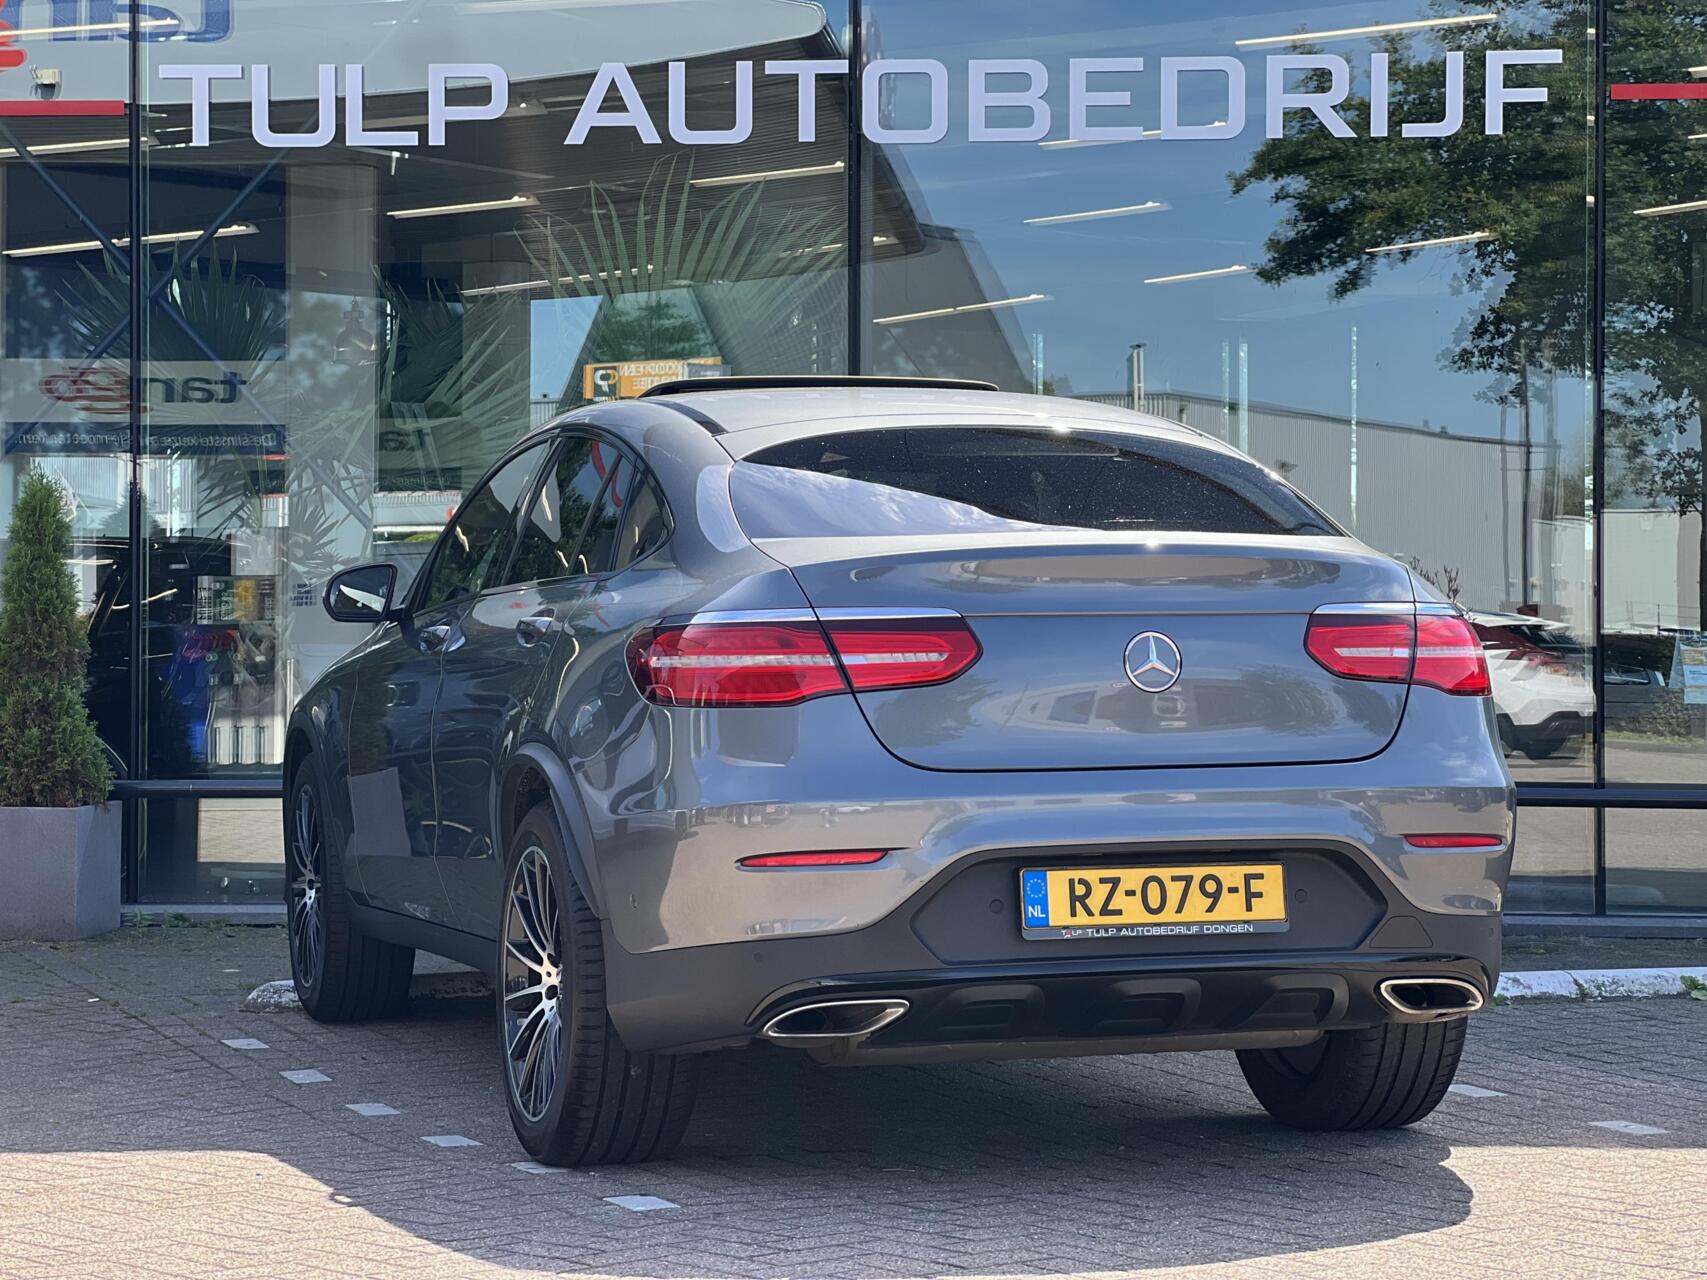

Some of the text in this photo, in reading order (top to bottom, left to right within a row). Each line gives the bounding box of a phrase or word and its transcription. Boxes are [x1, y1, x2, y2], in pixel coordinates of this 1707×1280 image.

[159, 49, 1563, 148] TULP AUTOBEDRIJF
[1068, 873, 1265, 918] RZ-079-F
[1028, 905, 1046, 918] NL
[1086, 923, 1254, 938] TULP AUTOBEDRIJF DONGEN
